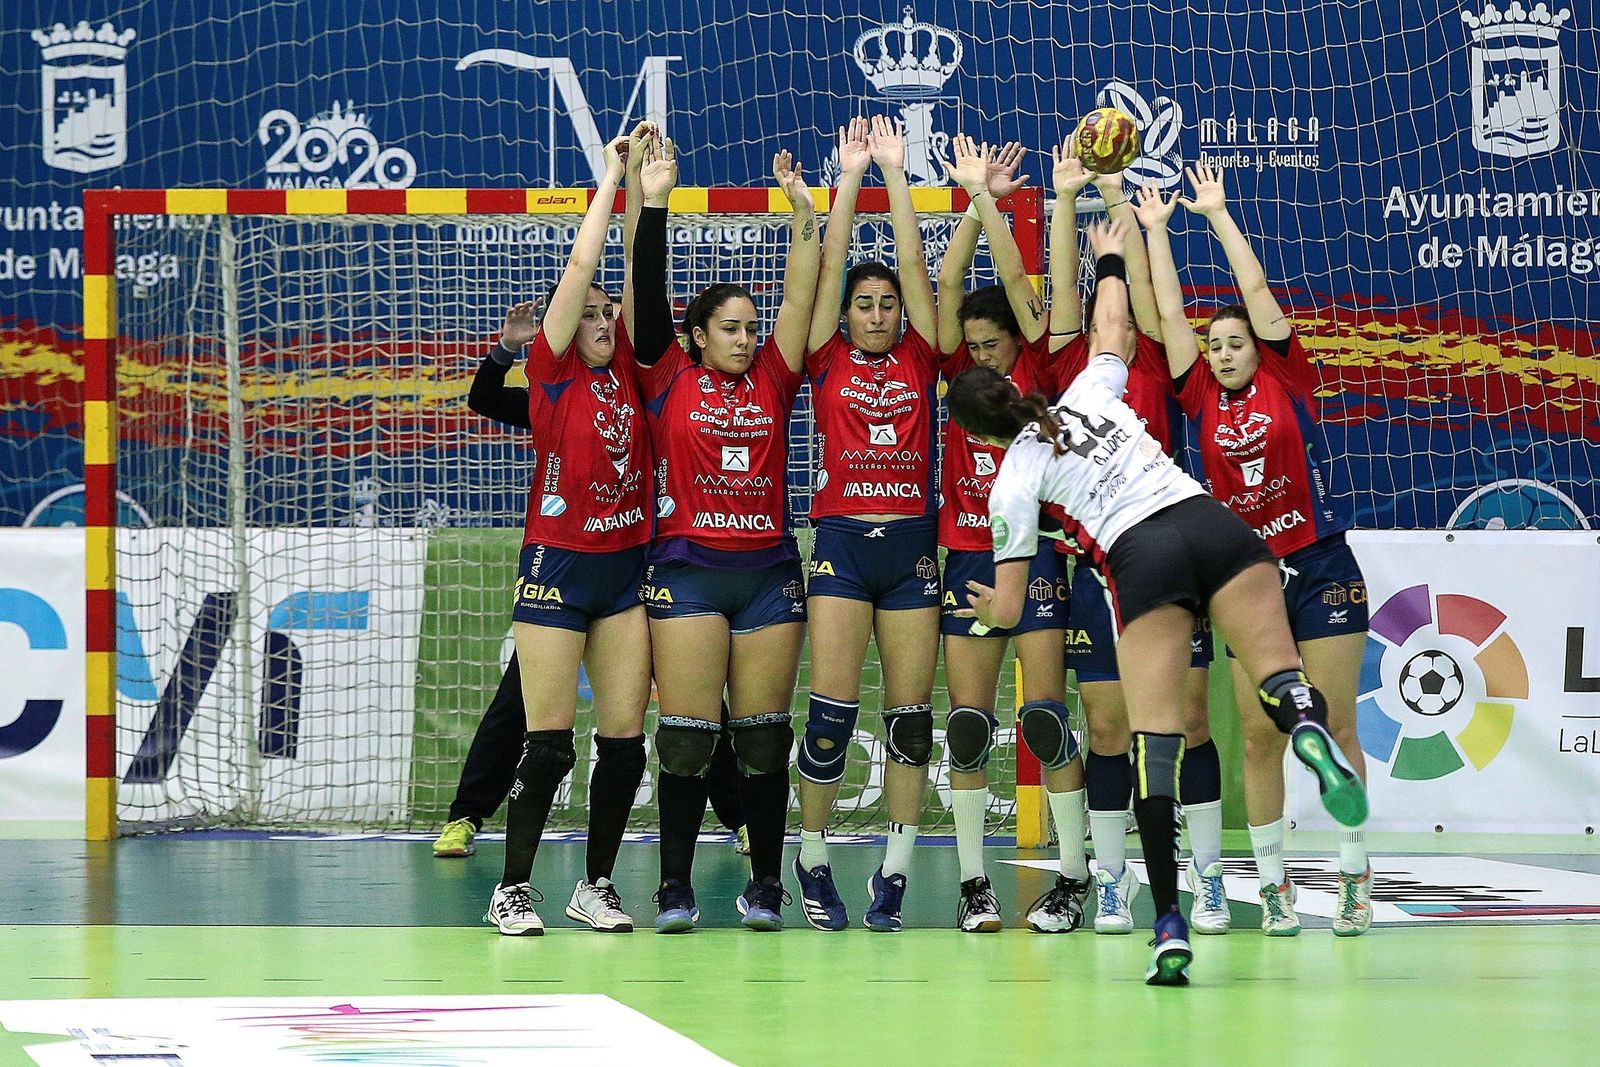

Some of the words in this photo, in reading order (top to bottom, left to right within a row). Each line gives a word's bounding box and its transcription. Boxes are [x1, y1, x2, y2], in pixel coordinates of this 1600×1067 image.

[258, 109, 417, 189] 2020
[1200, 150, 1250, 173] Deporte
[1255, 154, 1263, 173] y
[1269, 150, 1320, 168] Eventos
[536, 195, 577, 206] elan
[1417, 236, 1463, 268] de
[840, 387, 879, 408] Godoy
[689, 411, 730, 428] Godoy
[859, 407, 883, 418] mundo
[712, 429, 739, 438] mundo
[550, 456, 561, 492] GALEGO
